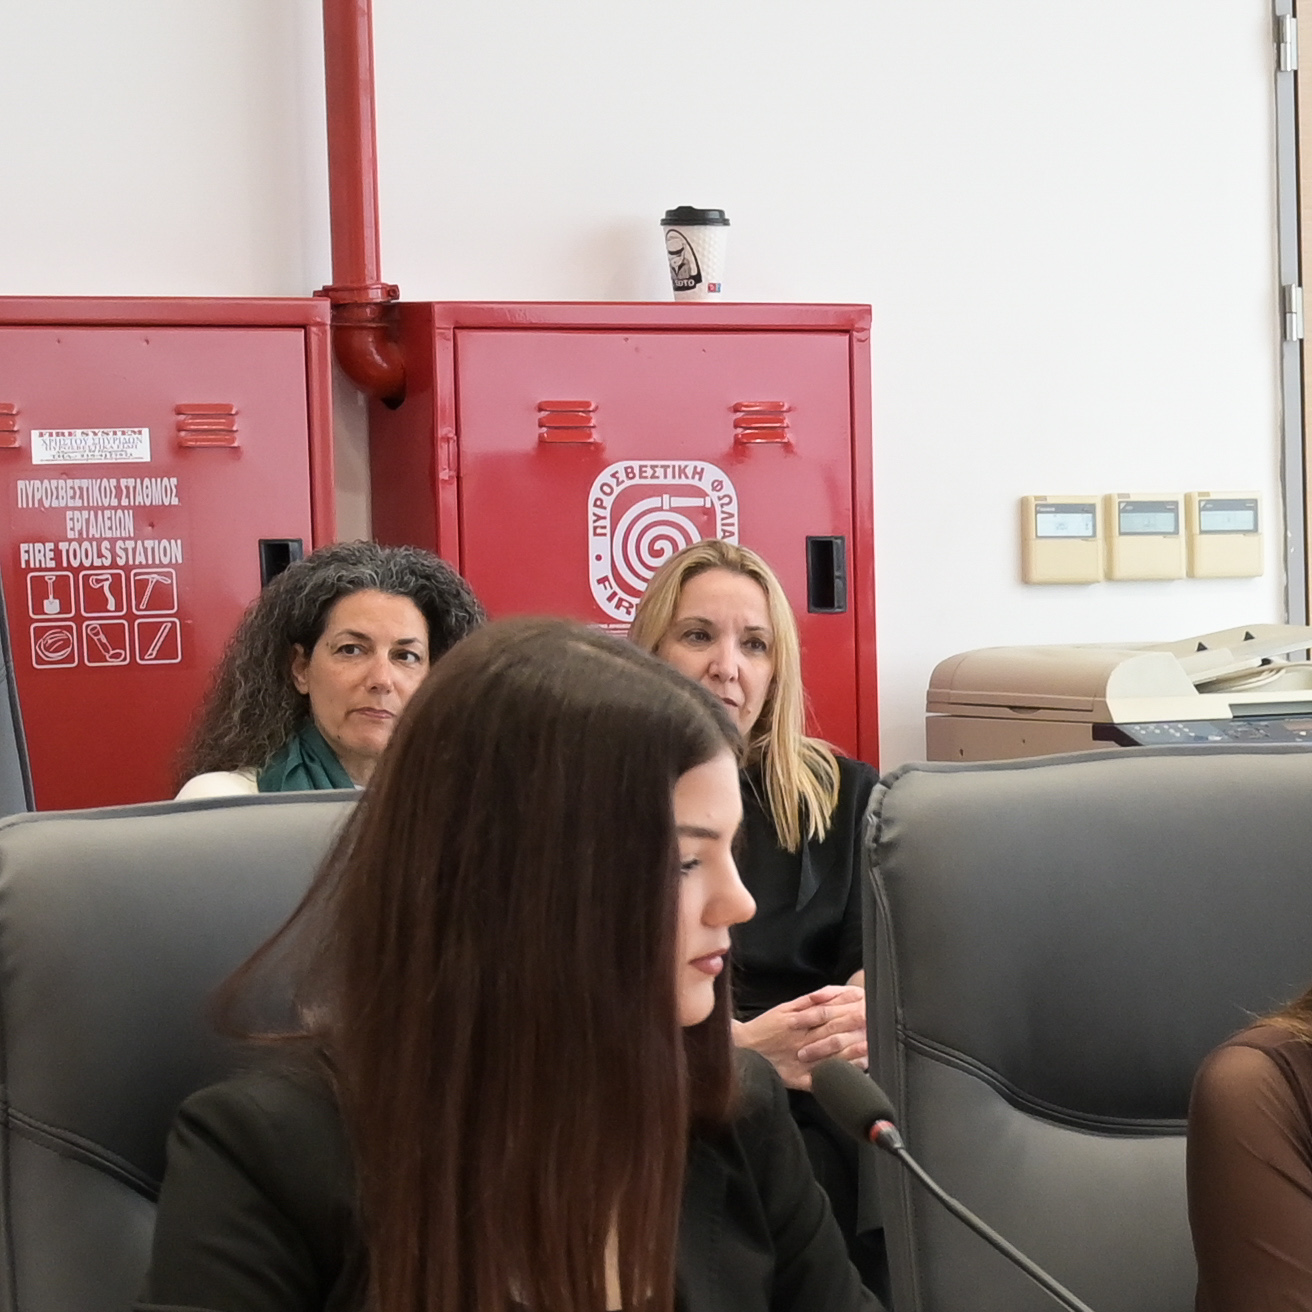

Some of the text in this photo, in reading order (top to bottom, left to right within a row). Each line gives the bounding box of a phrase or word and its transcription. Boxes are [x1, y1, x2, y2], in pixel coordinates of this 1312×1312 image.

[80, 429, 143, 437] SYSTEM
[17, 477, 180, 508] ΠΥΡΟΣΒΕΣΤΙΚΟΣ ΣΤΑΘΜΟΣ
[592, 464, 736, 540] ΠΥΡΟΣΒΕΣΤΙΚΗ ΦΩΛΙΑ
[66, 510, 135, 538] ΕΡΓΑΛΕΙΩΝ
[19, 539, 183, 568] FIRE TOOLS STATION
[596, 575, 635, 616] FIR
